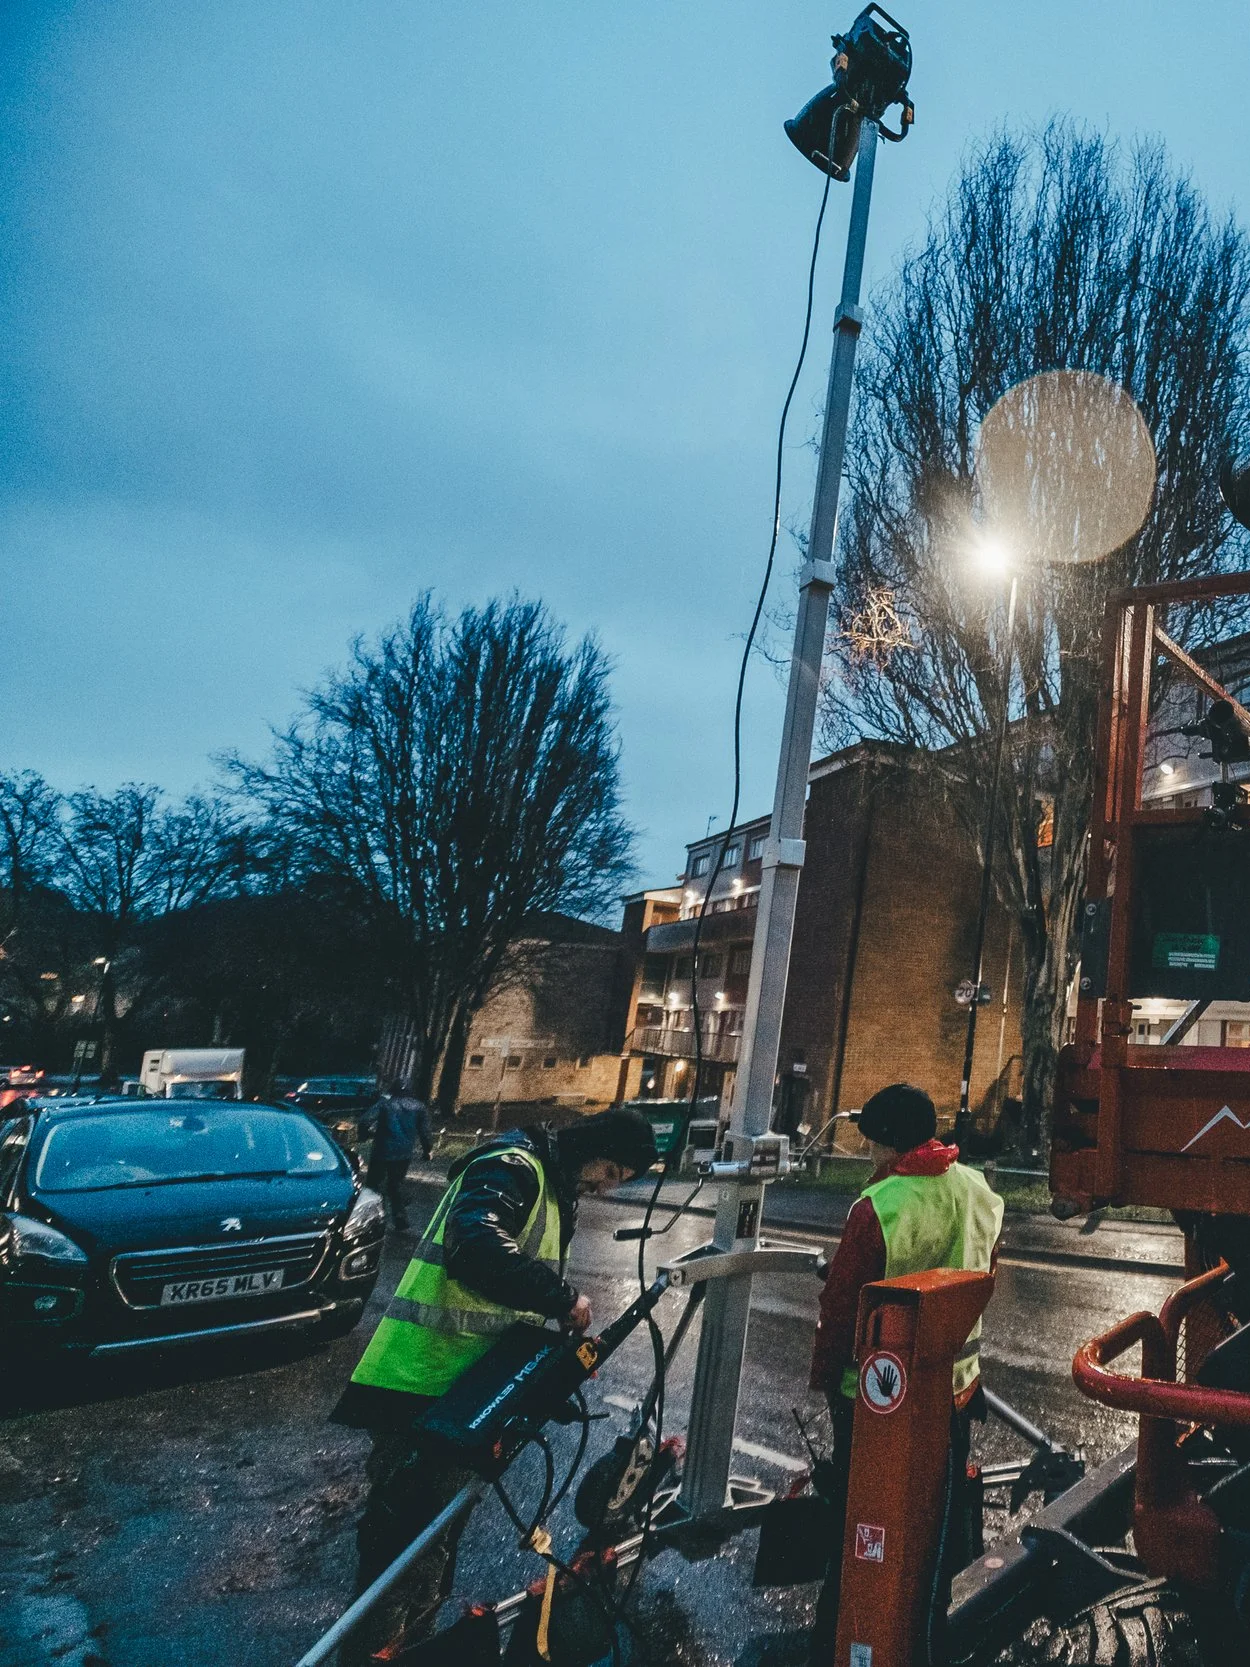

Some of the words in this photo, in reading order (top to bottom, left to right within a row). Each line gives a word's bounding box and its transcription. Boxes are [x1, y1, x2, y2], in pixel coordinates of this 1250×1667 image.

[959, 987, 972, 998] 20
[170, 1279, 229, 1301] KR65
[232, 1272, 275, 1293] MLV
[468, 1383, 515, 1430] KNOWLED
[514, 1345, 553, 1381] MG4K
